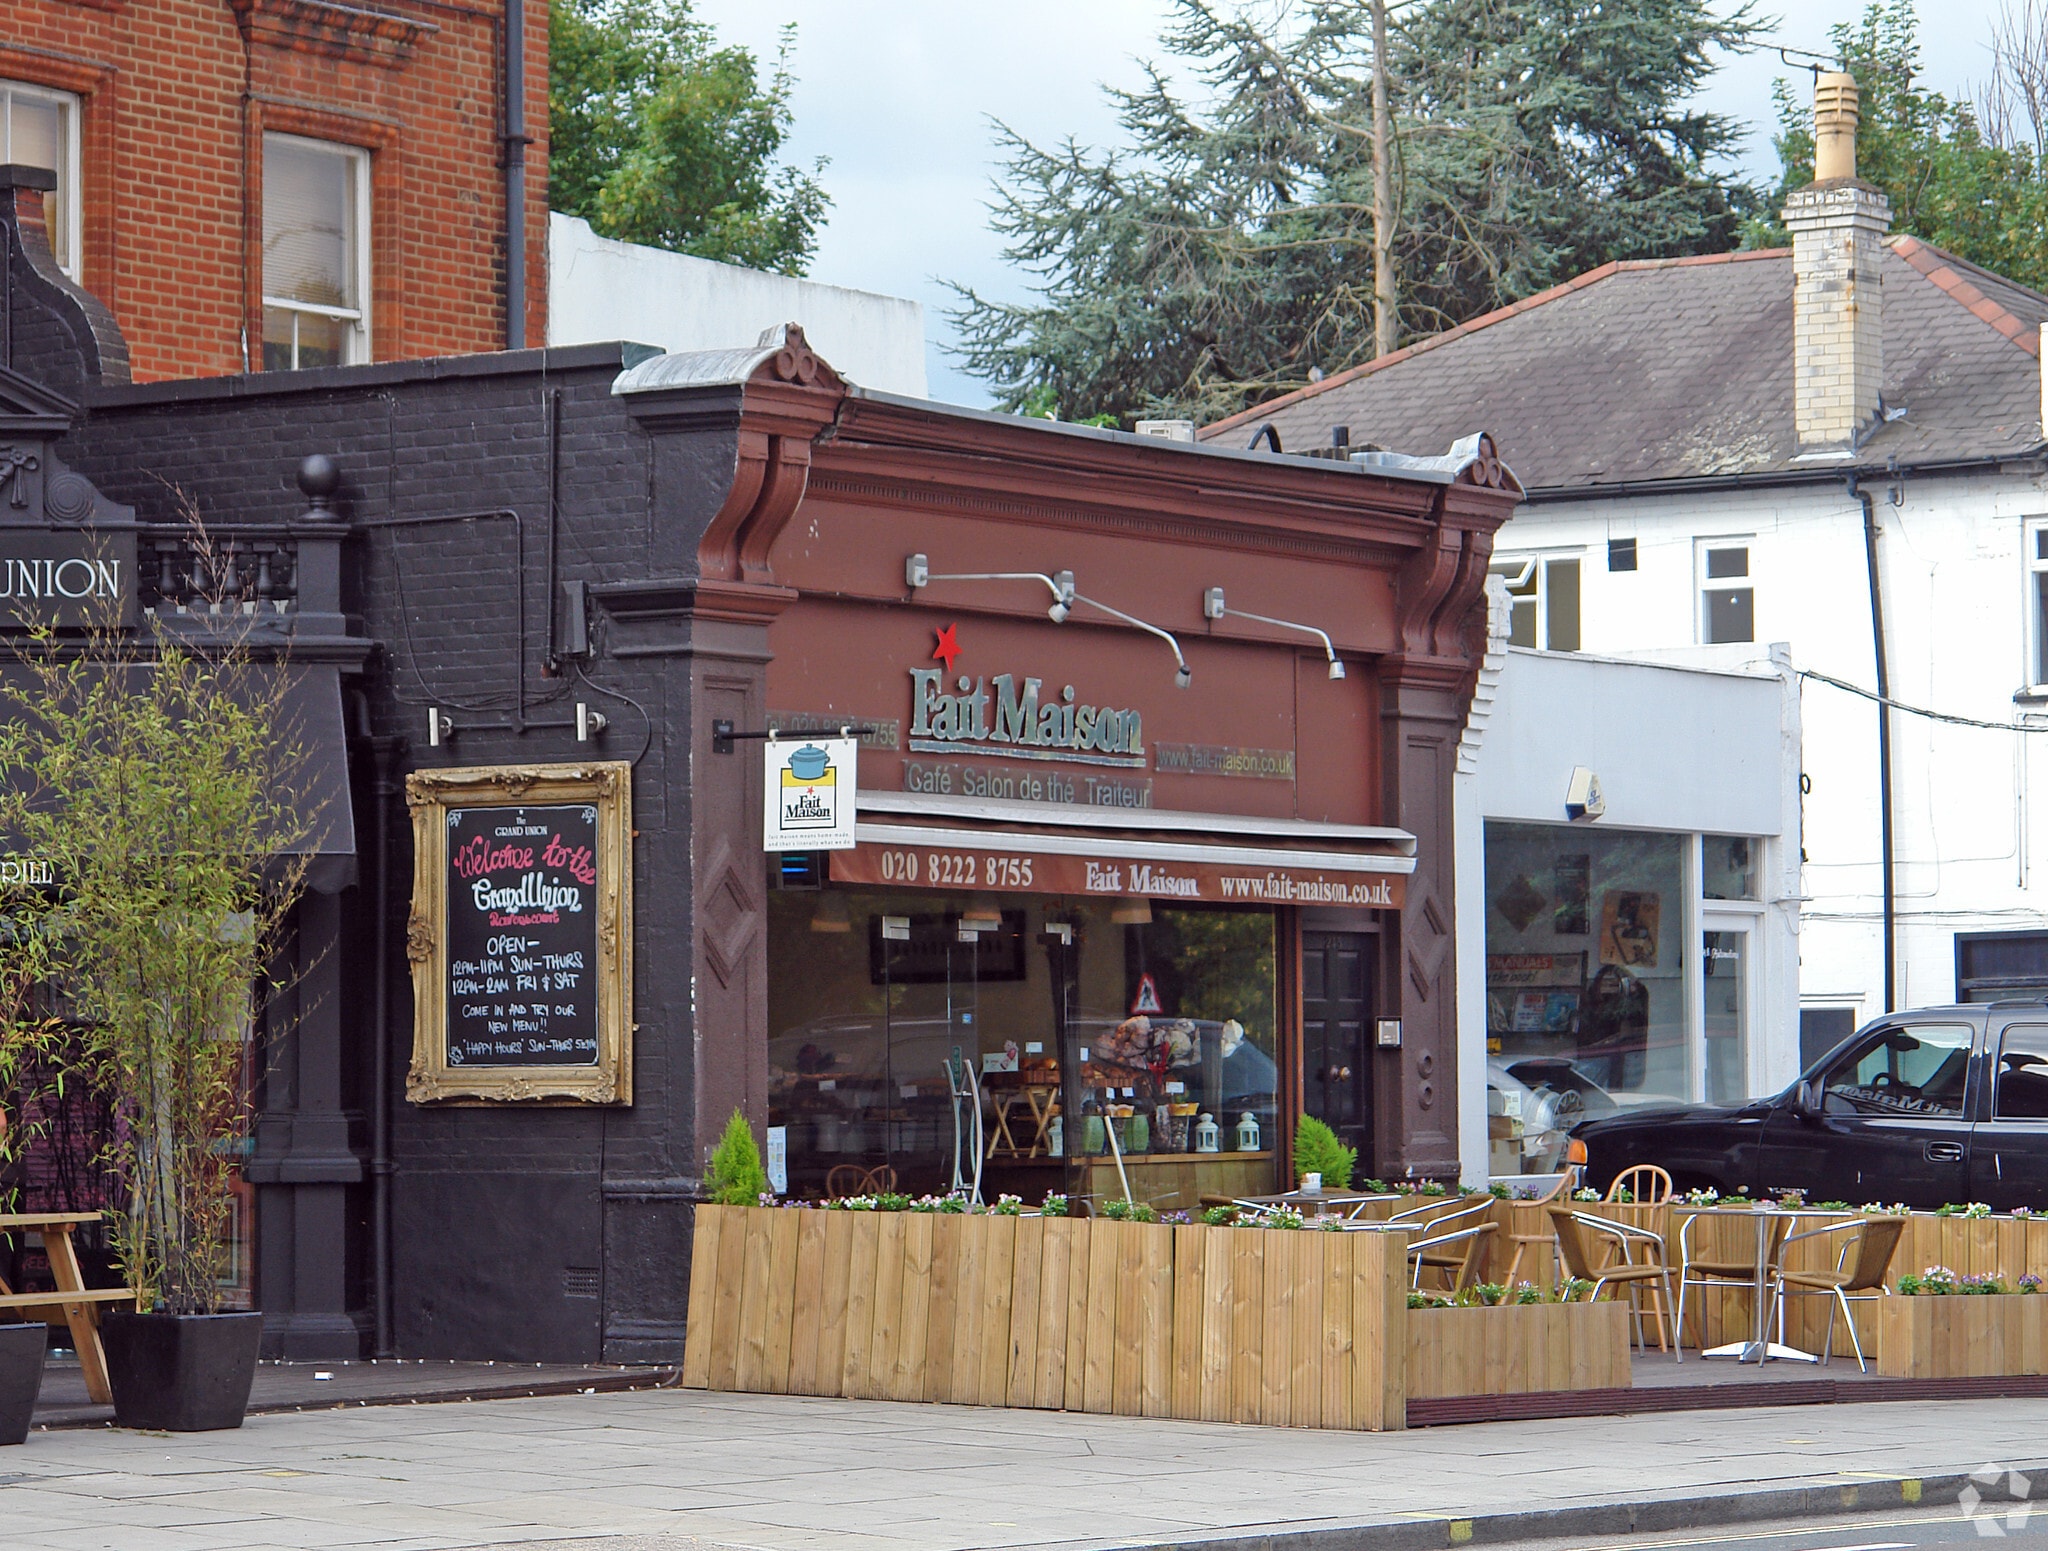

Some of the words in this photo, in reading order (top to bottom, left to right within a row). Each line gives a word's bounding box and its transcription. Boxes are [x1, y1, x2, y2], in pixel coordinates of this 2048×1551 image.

[909, 666, 989, 740] Fait
[990, 673, 1145, 755] Maison
[1158, 748, 1293, 775] www.fait-maison.co.uk
[800, 795, 821, 808] Fait
[908, 766, 951, 794] Café
[963, 770, 1013, 799] Salon
[1020, 774, 1042, 798] de
[1048, 776, 1074, 803] thé
[1085, 778, 1150, 808] Traiteur
[785, 805, 831, 818] Maison
[494, 826, 524, 837] GRAND
[525, 825, 547, 836] UNION
[453, 835, 534, 878] Welcome
[541, 833, 573, 867] to
[569, 845, 596, 885] the
[881, 851, 918, 881] 020
[928, 853, 976, 884] 8222
[985, 856, 1033, 887] 8755
[1085, 862, 1121, 892] Fait
[1128, 863, 1200, 897] Maison
[1220, 872, 1392, 905] www.fait-maison.co.uk
[516, 974, 537, 992] FRI
[554, 971, 580, 990] SAT
